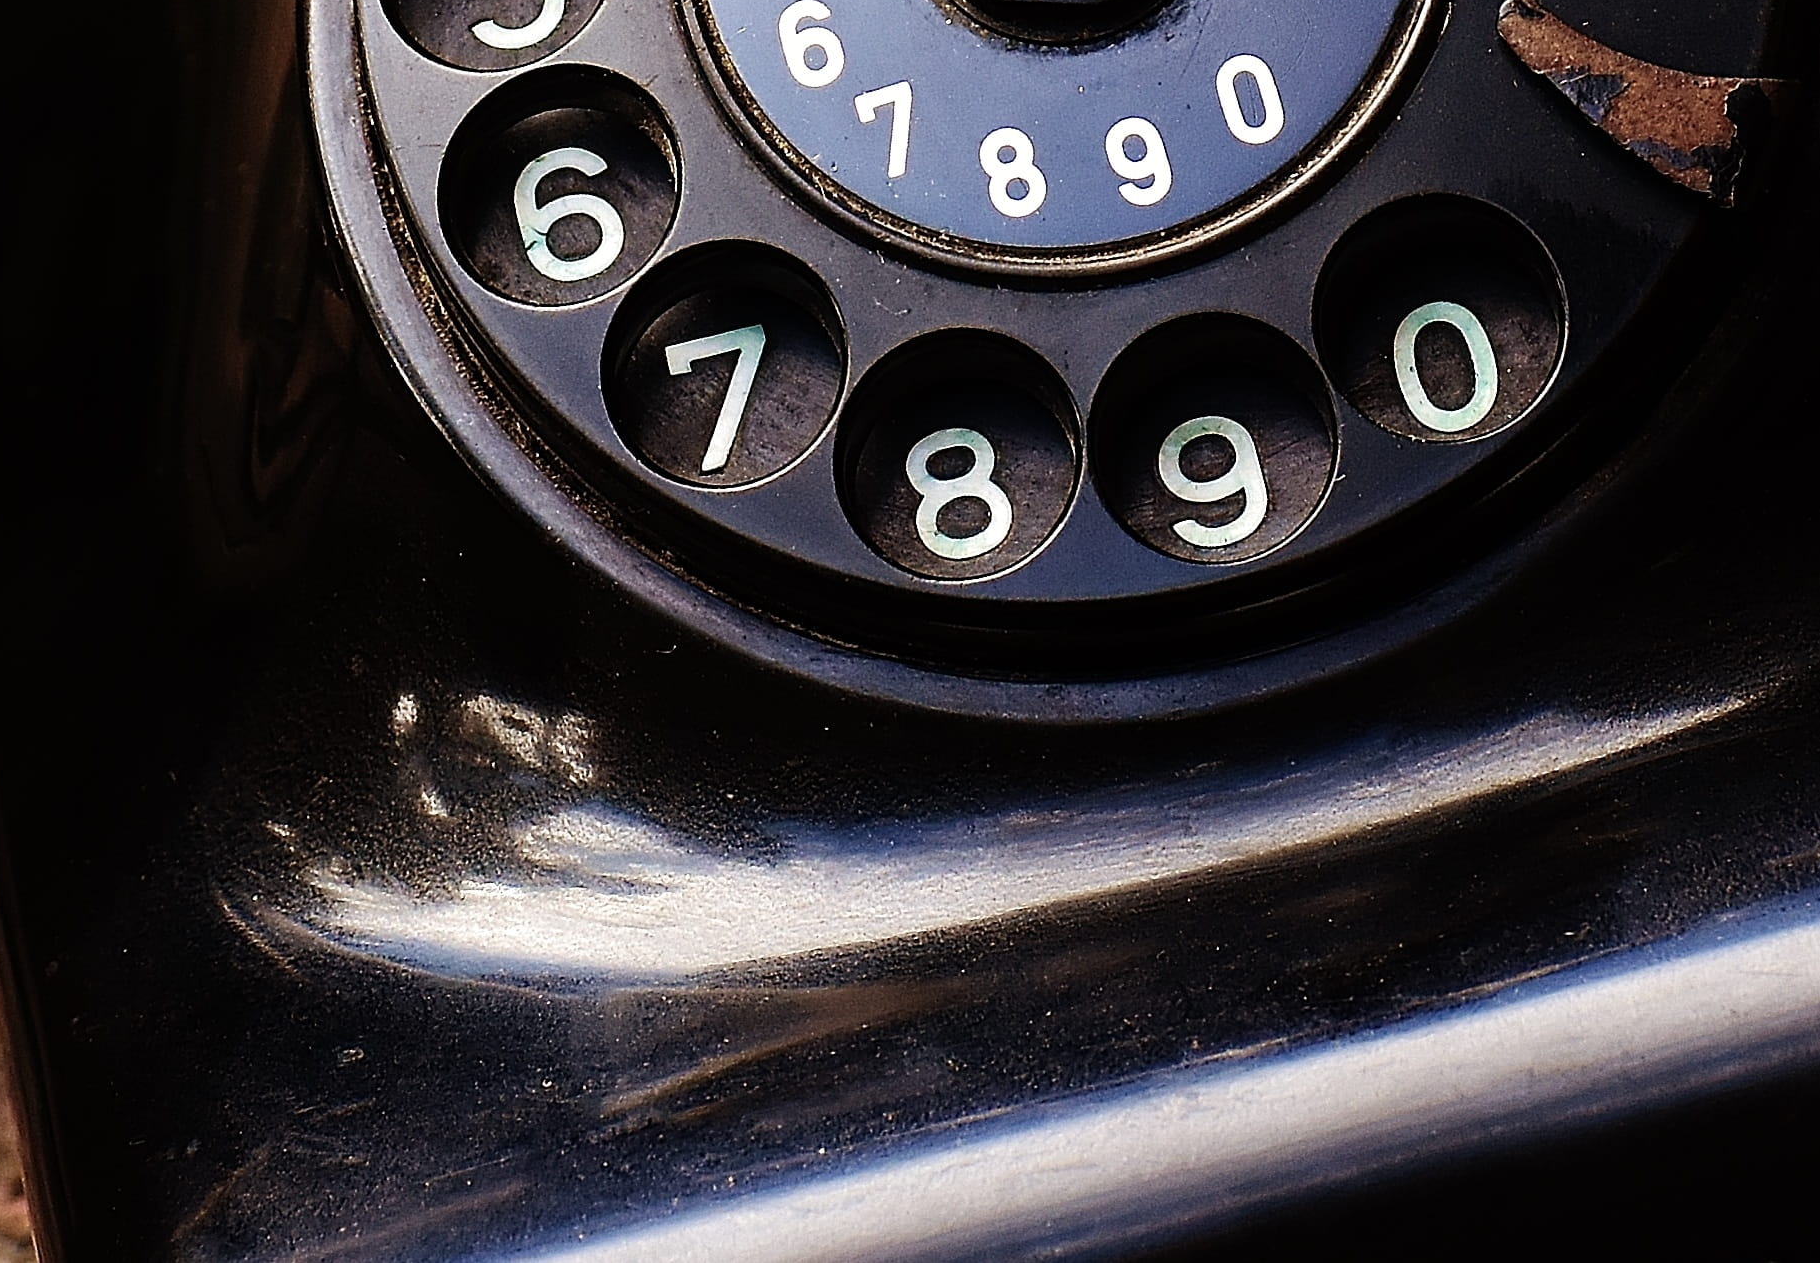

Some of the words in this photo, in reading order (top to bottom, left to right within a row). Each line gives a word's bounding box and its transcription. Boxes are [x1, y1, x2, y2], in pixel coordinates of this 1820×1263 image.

[853, 80, 914, 179] 7
[1104, 116, 1173, 207] 9
[1215, 53, 1285, 145] 0
[512, 145, 626, 283] 6
[978, 126, 1048, 219] 8
[663, 325, 767, 473] 7
[1392, 300, 1500, 434] 0
[904, 426, 1014, 561] 8
[1157, 414, 1269, 549] 9
